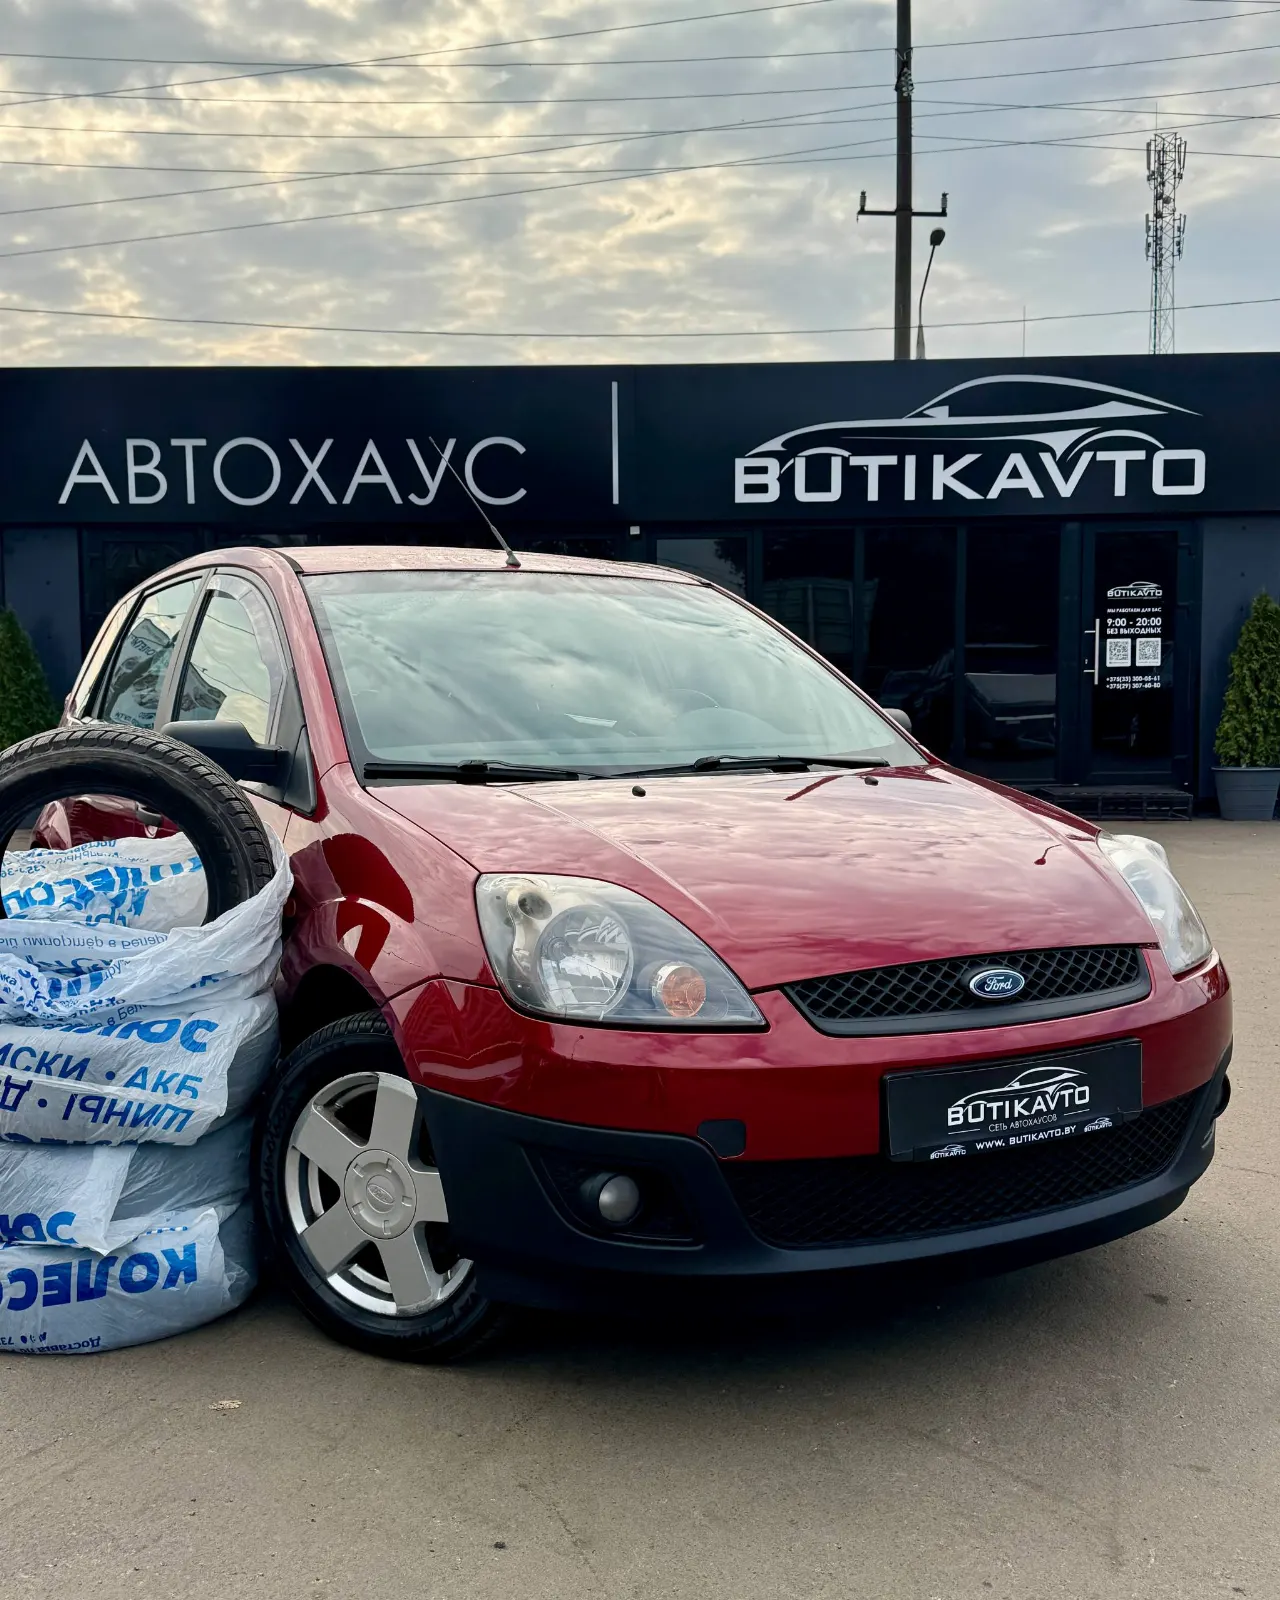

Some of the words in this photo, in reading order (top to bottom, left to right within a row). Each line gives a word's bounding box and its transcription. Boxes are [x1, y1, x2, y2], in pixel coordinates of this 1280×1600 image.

[58, 436, 527, 506] АВТОХАУС
[734, 448, 1206, 503] BUTIKAVTO
[1107, 589, 1163, 597] BUTIKAVTO
[1107, 618, 1127, 627] 9:00
[1135, 617, 1162, 626] 20:00
[984, 976, 1013, 992] Ford
[123, 1066, 203, 1100] АКБ
[62, 1094, 195, 1133] ШИНЫ
[947, 1086, 1090, 1127] BUTIKAVTO
[988, 1123, 1008, 1132] СЕТЬ
[1009, 1113, 1058, 1130] АВТОХАУСОВ
[930, 1149, 967, 1160] BUTIKAVTO
[0, 1242, 198, 1311] КОЛЕС
